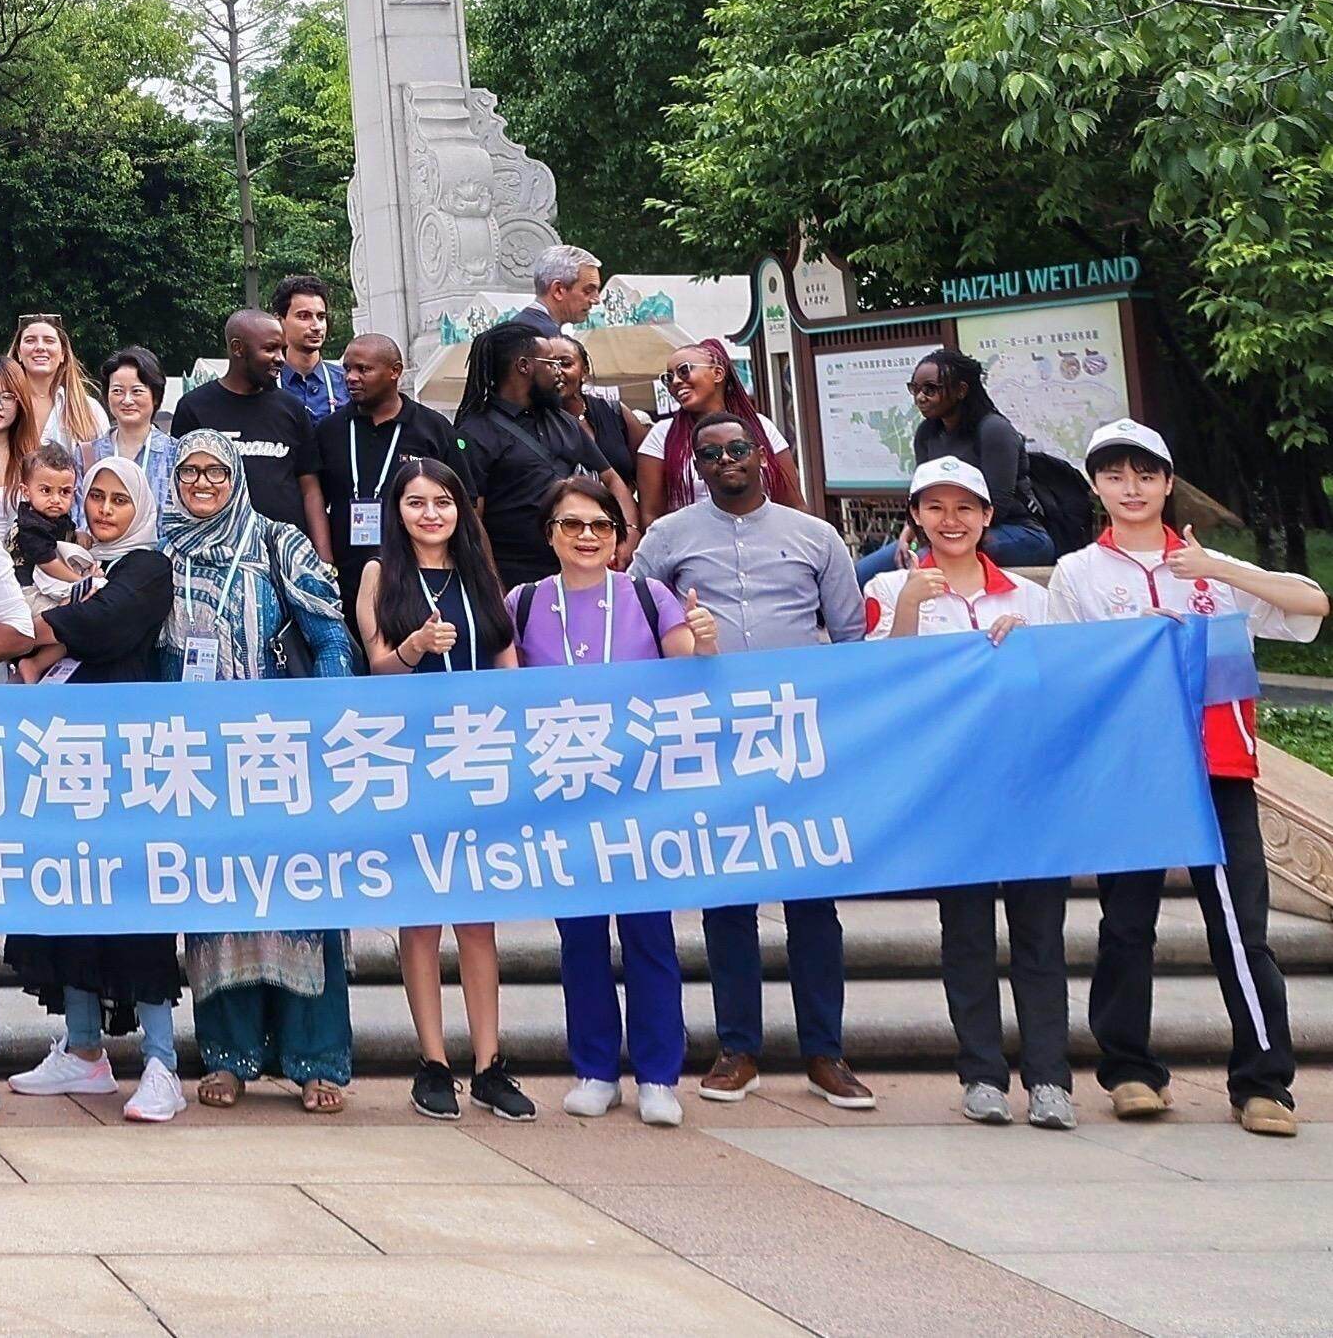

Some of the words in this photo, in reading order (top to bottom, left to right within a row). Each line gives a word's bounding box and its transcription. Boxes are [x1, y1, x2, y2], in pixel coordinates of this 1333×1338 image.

[941, 271, 1021, 304] HAIZHU
[1025, 256, 1141, 294] WETLAND
[145, 842, 393, 918] Buyers
[411, 825, 575, 893] Visit
[589, 811, 853, 883] Haizhu
